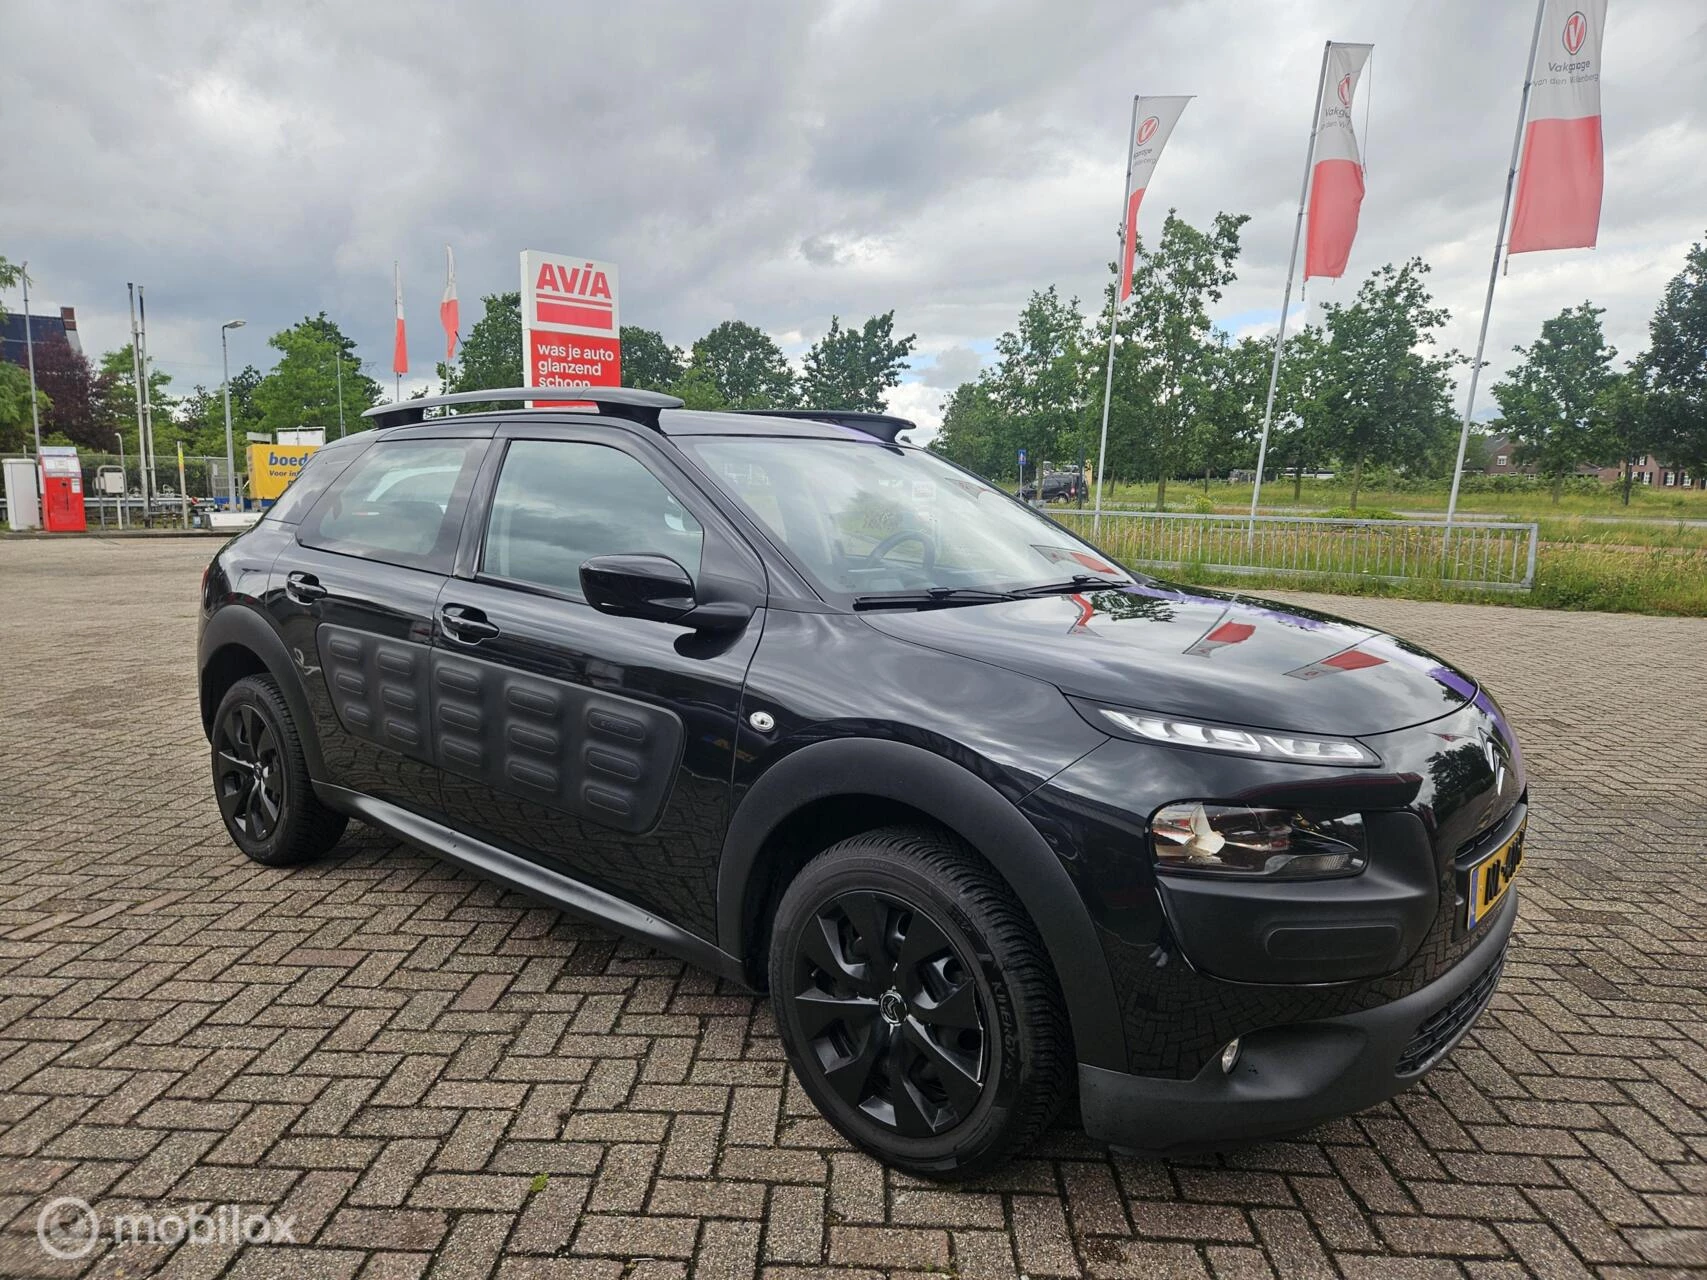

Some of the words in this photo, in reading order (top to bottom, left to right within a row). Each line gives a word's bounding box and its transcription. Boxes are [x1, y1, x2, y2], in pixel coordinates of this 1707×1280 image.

[537, 343, 566, 357] was
[568, 343, 581, 361] je
[583, 347, 615, 361] auto
[538, 357, 602, 377] glanzend
